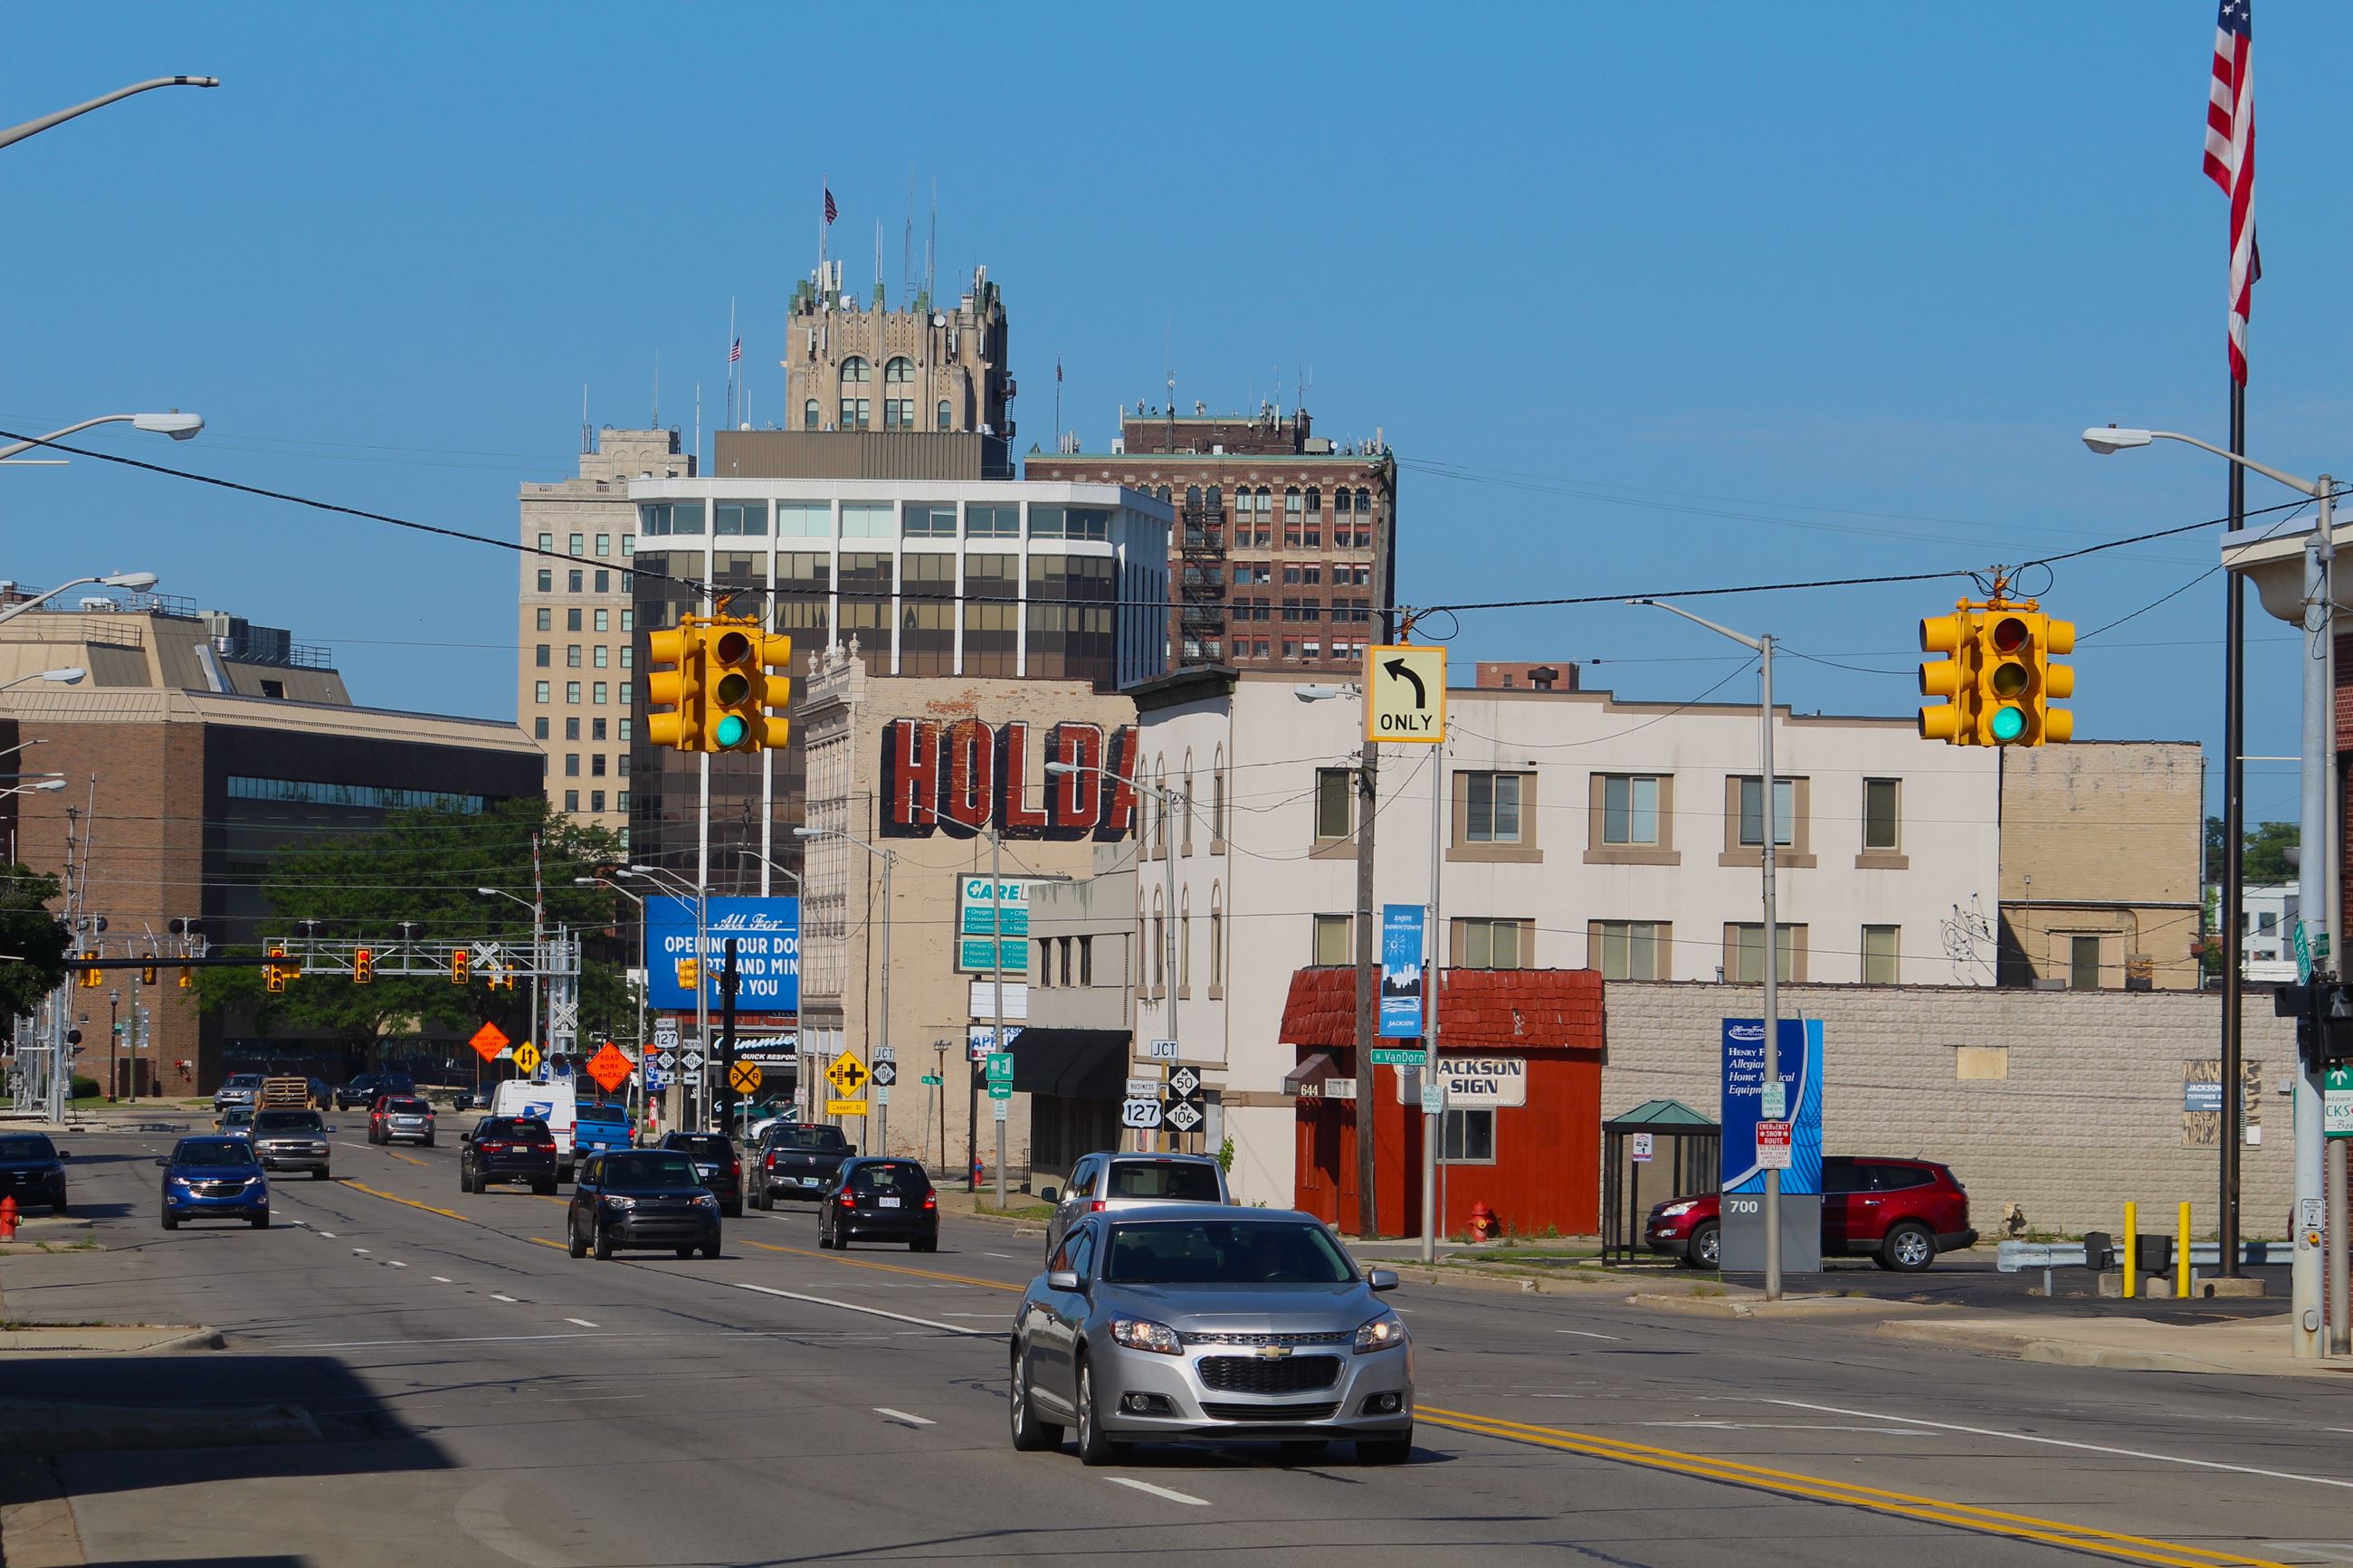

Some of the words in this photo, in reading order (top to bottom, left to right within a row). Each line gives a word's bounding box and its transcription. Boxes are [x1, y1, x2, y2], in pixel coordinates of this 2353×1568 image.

[1380, 713, 1434, 731] ONLY
[971, 908, 993, 917] Oxygen
[714, 913, 748, 930] All
[750, 913, 783, 930] For
[737, 936, 768, 955] OUR
[736, 958, 766, 975] AND
[748, 979, 778, 996] YOU
[1387, 1020, 1415, 1029] JACKSON
[656, 1033, 677, 1045] 127
[875, 1048, 893, 1059] JCT
[1153, 1042, 1176, 1056] JCT
[1729, 1047, 1757, 1056] HENRY
[1758, 1048, 1782, 1057] FD
[662, 1058, 672, 1066] 50
[685, 1058, 700, 1066] 106
[741, 1052, 766, 1060] QUICK
[767, 1053, 797, 1061] RESPON
[1376, 1052, 1381, 1060] N
[1385, 1050, 1424, 1063] VanDorn
[732, 1072, 738, 1080] R
[752, 1072, 759, 1080] R
[878, 1069, 891, 1079] 106
[1729, 1071, 1757, 1082] Home
[1758, 1071, 1796, 1082] Mical
[1176, 1077, 1193, 1089] 50
[1451, 1079, 1498, 1094] SIGN
[1769, 1084, 1778, 1092] 30
[2186, 1084, 2222, 1092] JACKSON
[1300, 1083, 1319, 1096] 644
[1466, 1097, 1499, 1105] MICHIGAN
[832, 1104, 853, 1112] Cooper
[1127, 1104, 1157, 1122] 127
[1174, 1111, 1194, 1124] 106
[1729, 1201, 1758, 1213] 700
